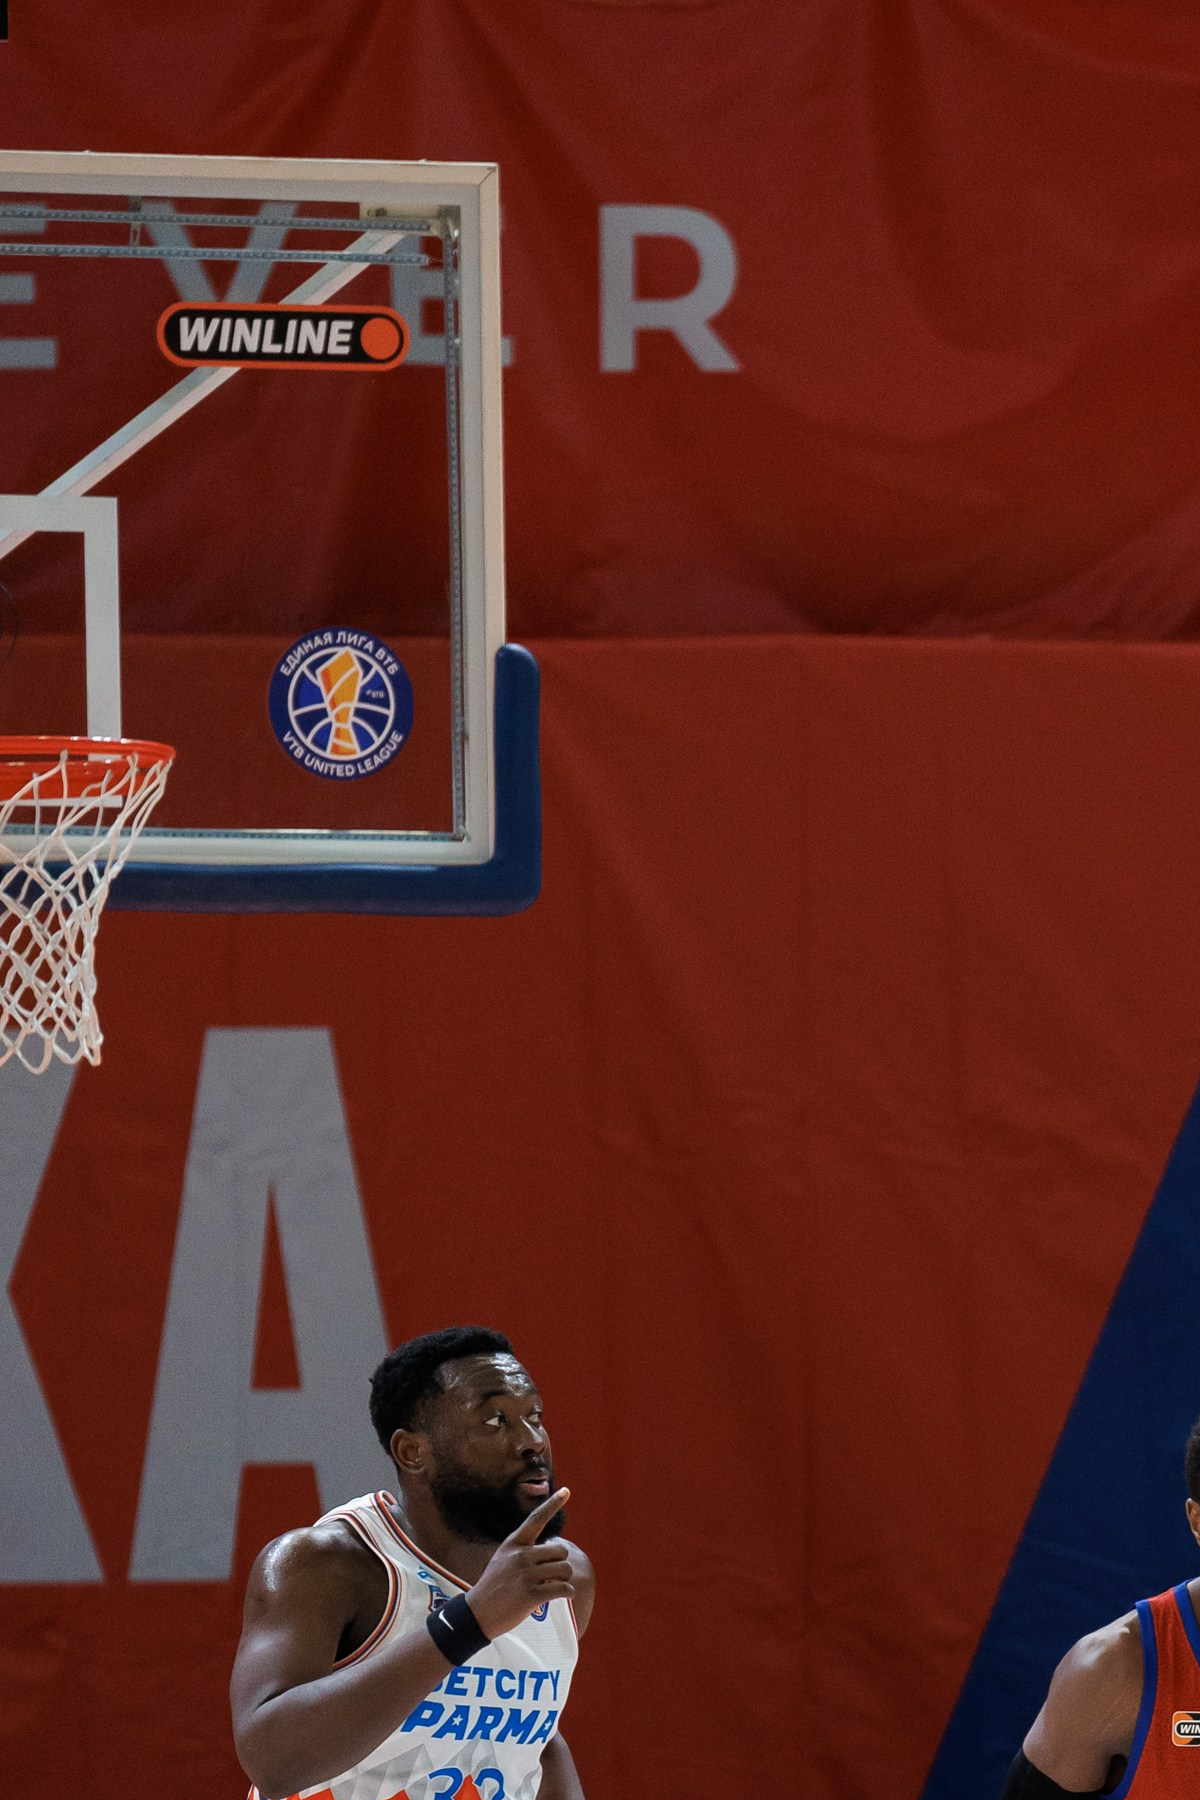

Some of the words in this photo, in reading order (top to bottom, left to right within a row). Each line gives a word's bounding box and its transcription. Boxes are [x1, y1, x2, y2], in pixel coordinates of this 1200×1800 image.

[179, 316, 354, 355] WINLINE
[280, 631, 333, 677] ЕДИНАЯ
[336, 631, 373, 653] ЛИГА
[375, 648, 399, 676] ВТБ
[282, 731, 305, 759] VTB
[304, 755, 356, 777] UNITED
[357, 730, 404, 775] LEAGUE
[400, 1700, 558, 1745] PARMA
